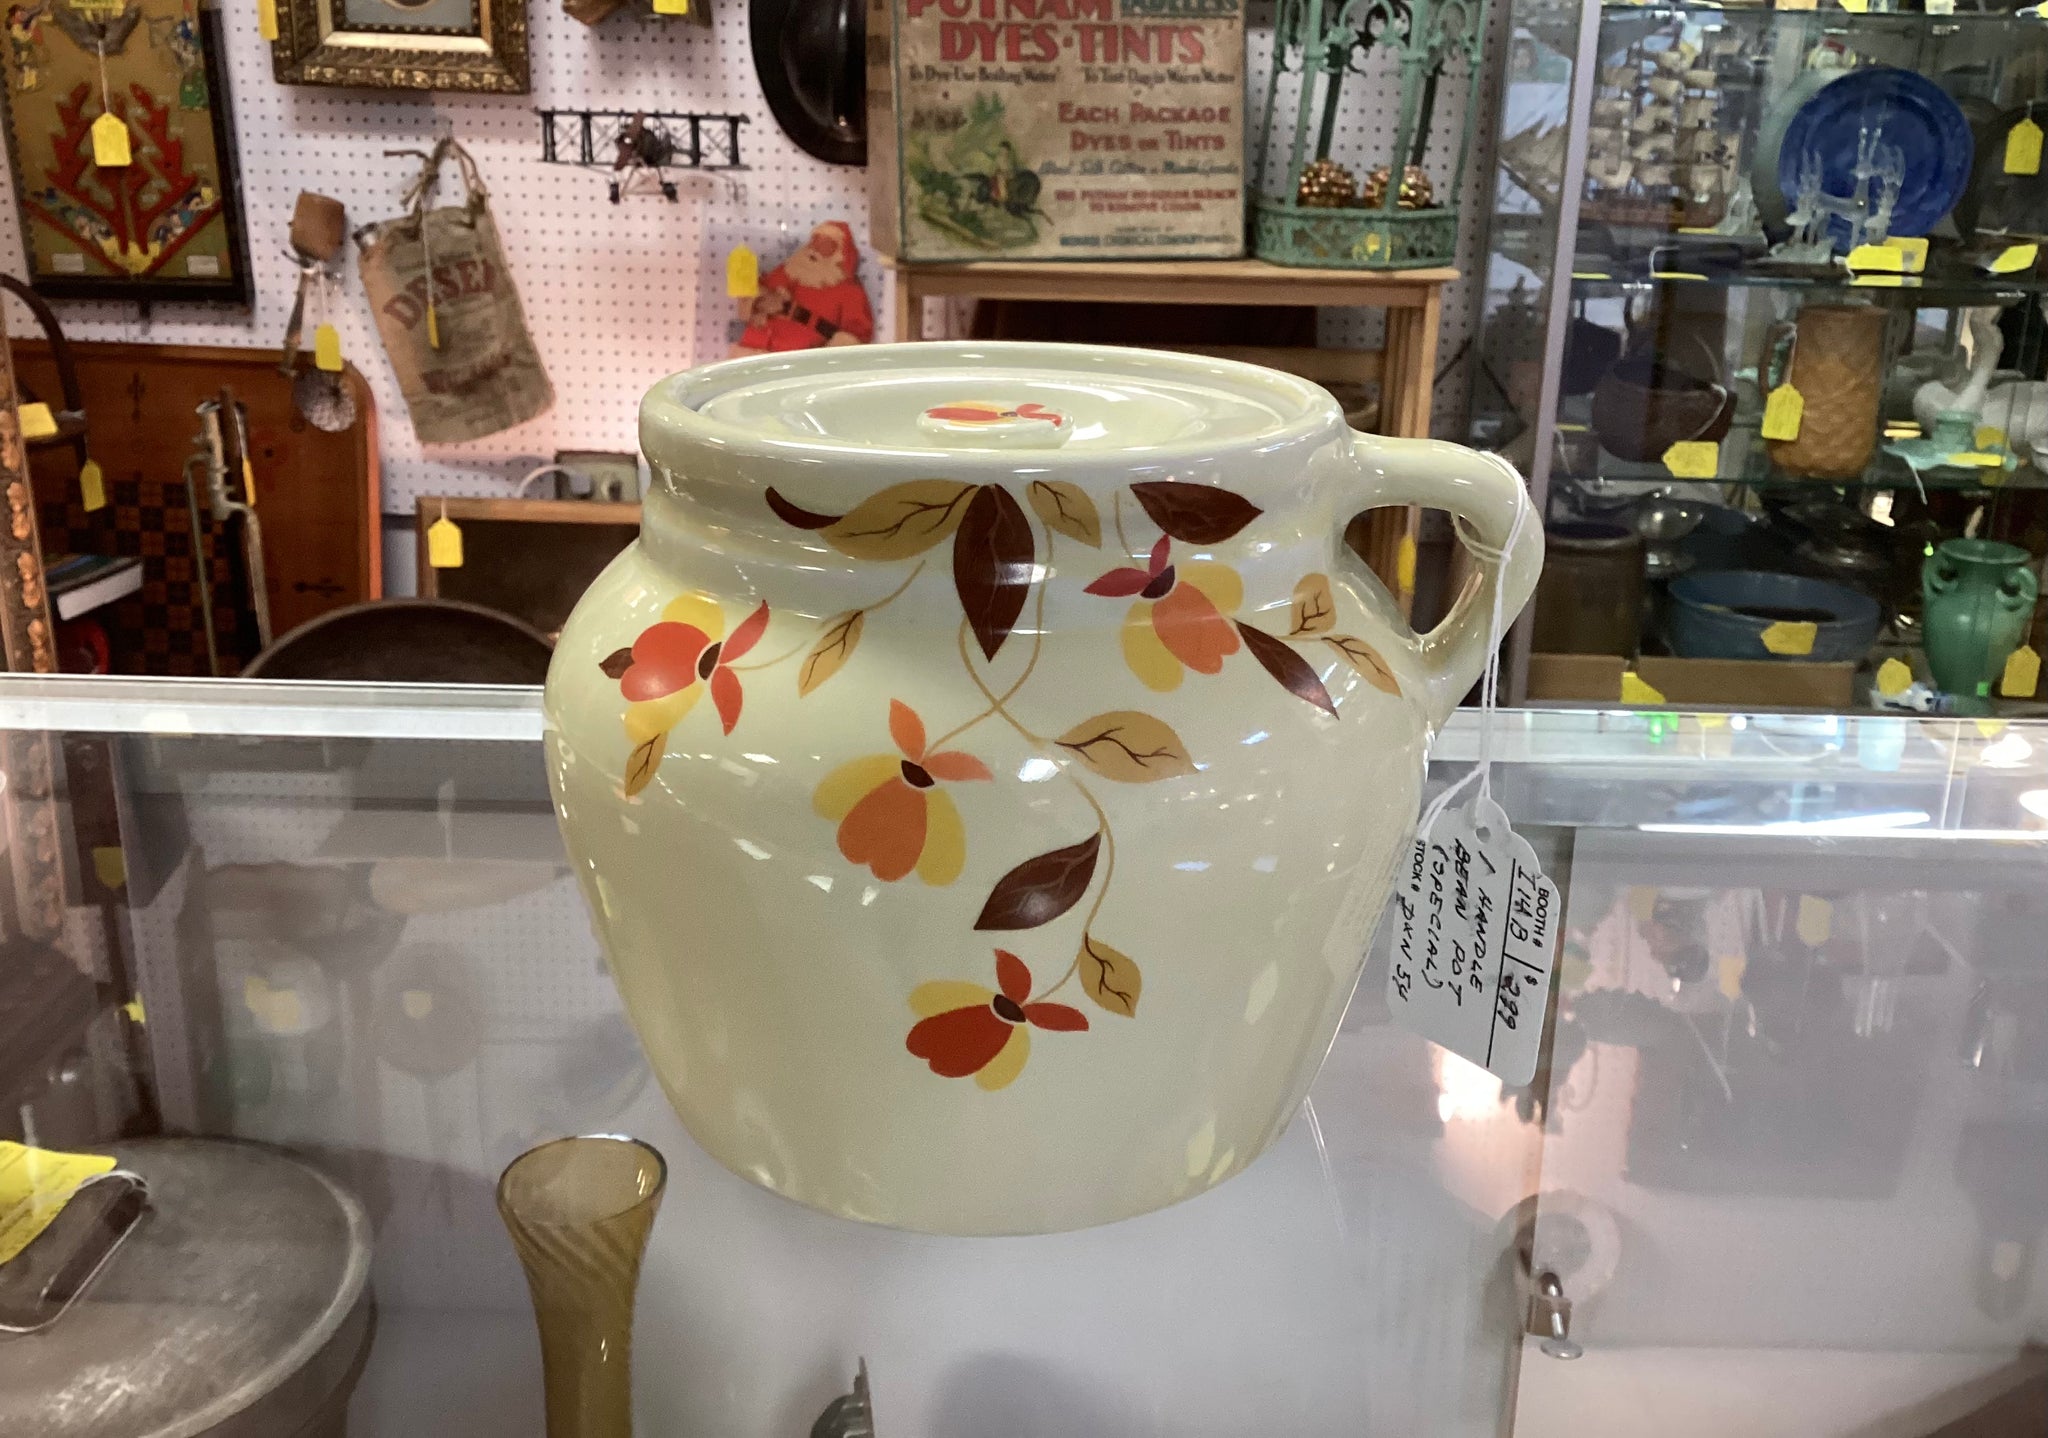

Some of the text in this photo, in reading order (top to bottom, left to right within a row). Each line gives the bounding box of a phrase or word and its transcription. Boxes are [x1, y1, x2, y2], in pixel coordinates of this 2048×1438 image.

[1411, 839, 1426, 883] STOCK
[1533, 887, 1550, 937] BOOTH
[1421, 844, 1450, 989] (SPECIAL)
[1447, 838, 1472, 1007] BEAN POT
[1469, 887, 1494, 994] HANDLE
